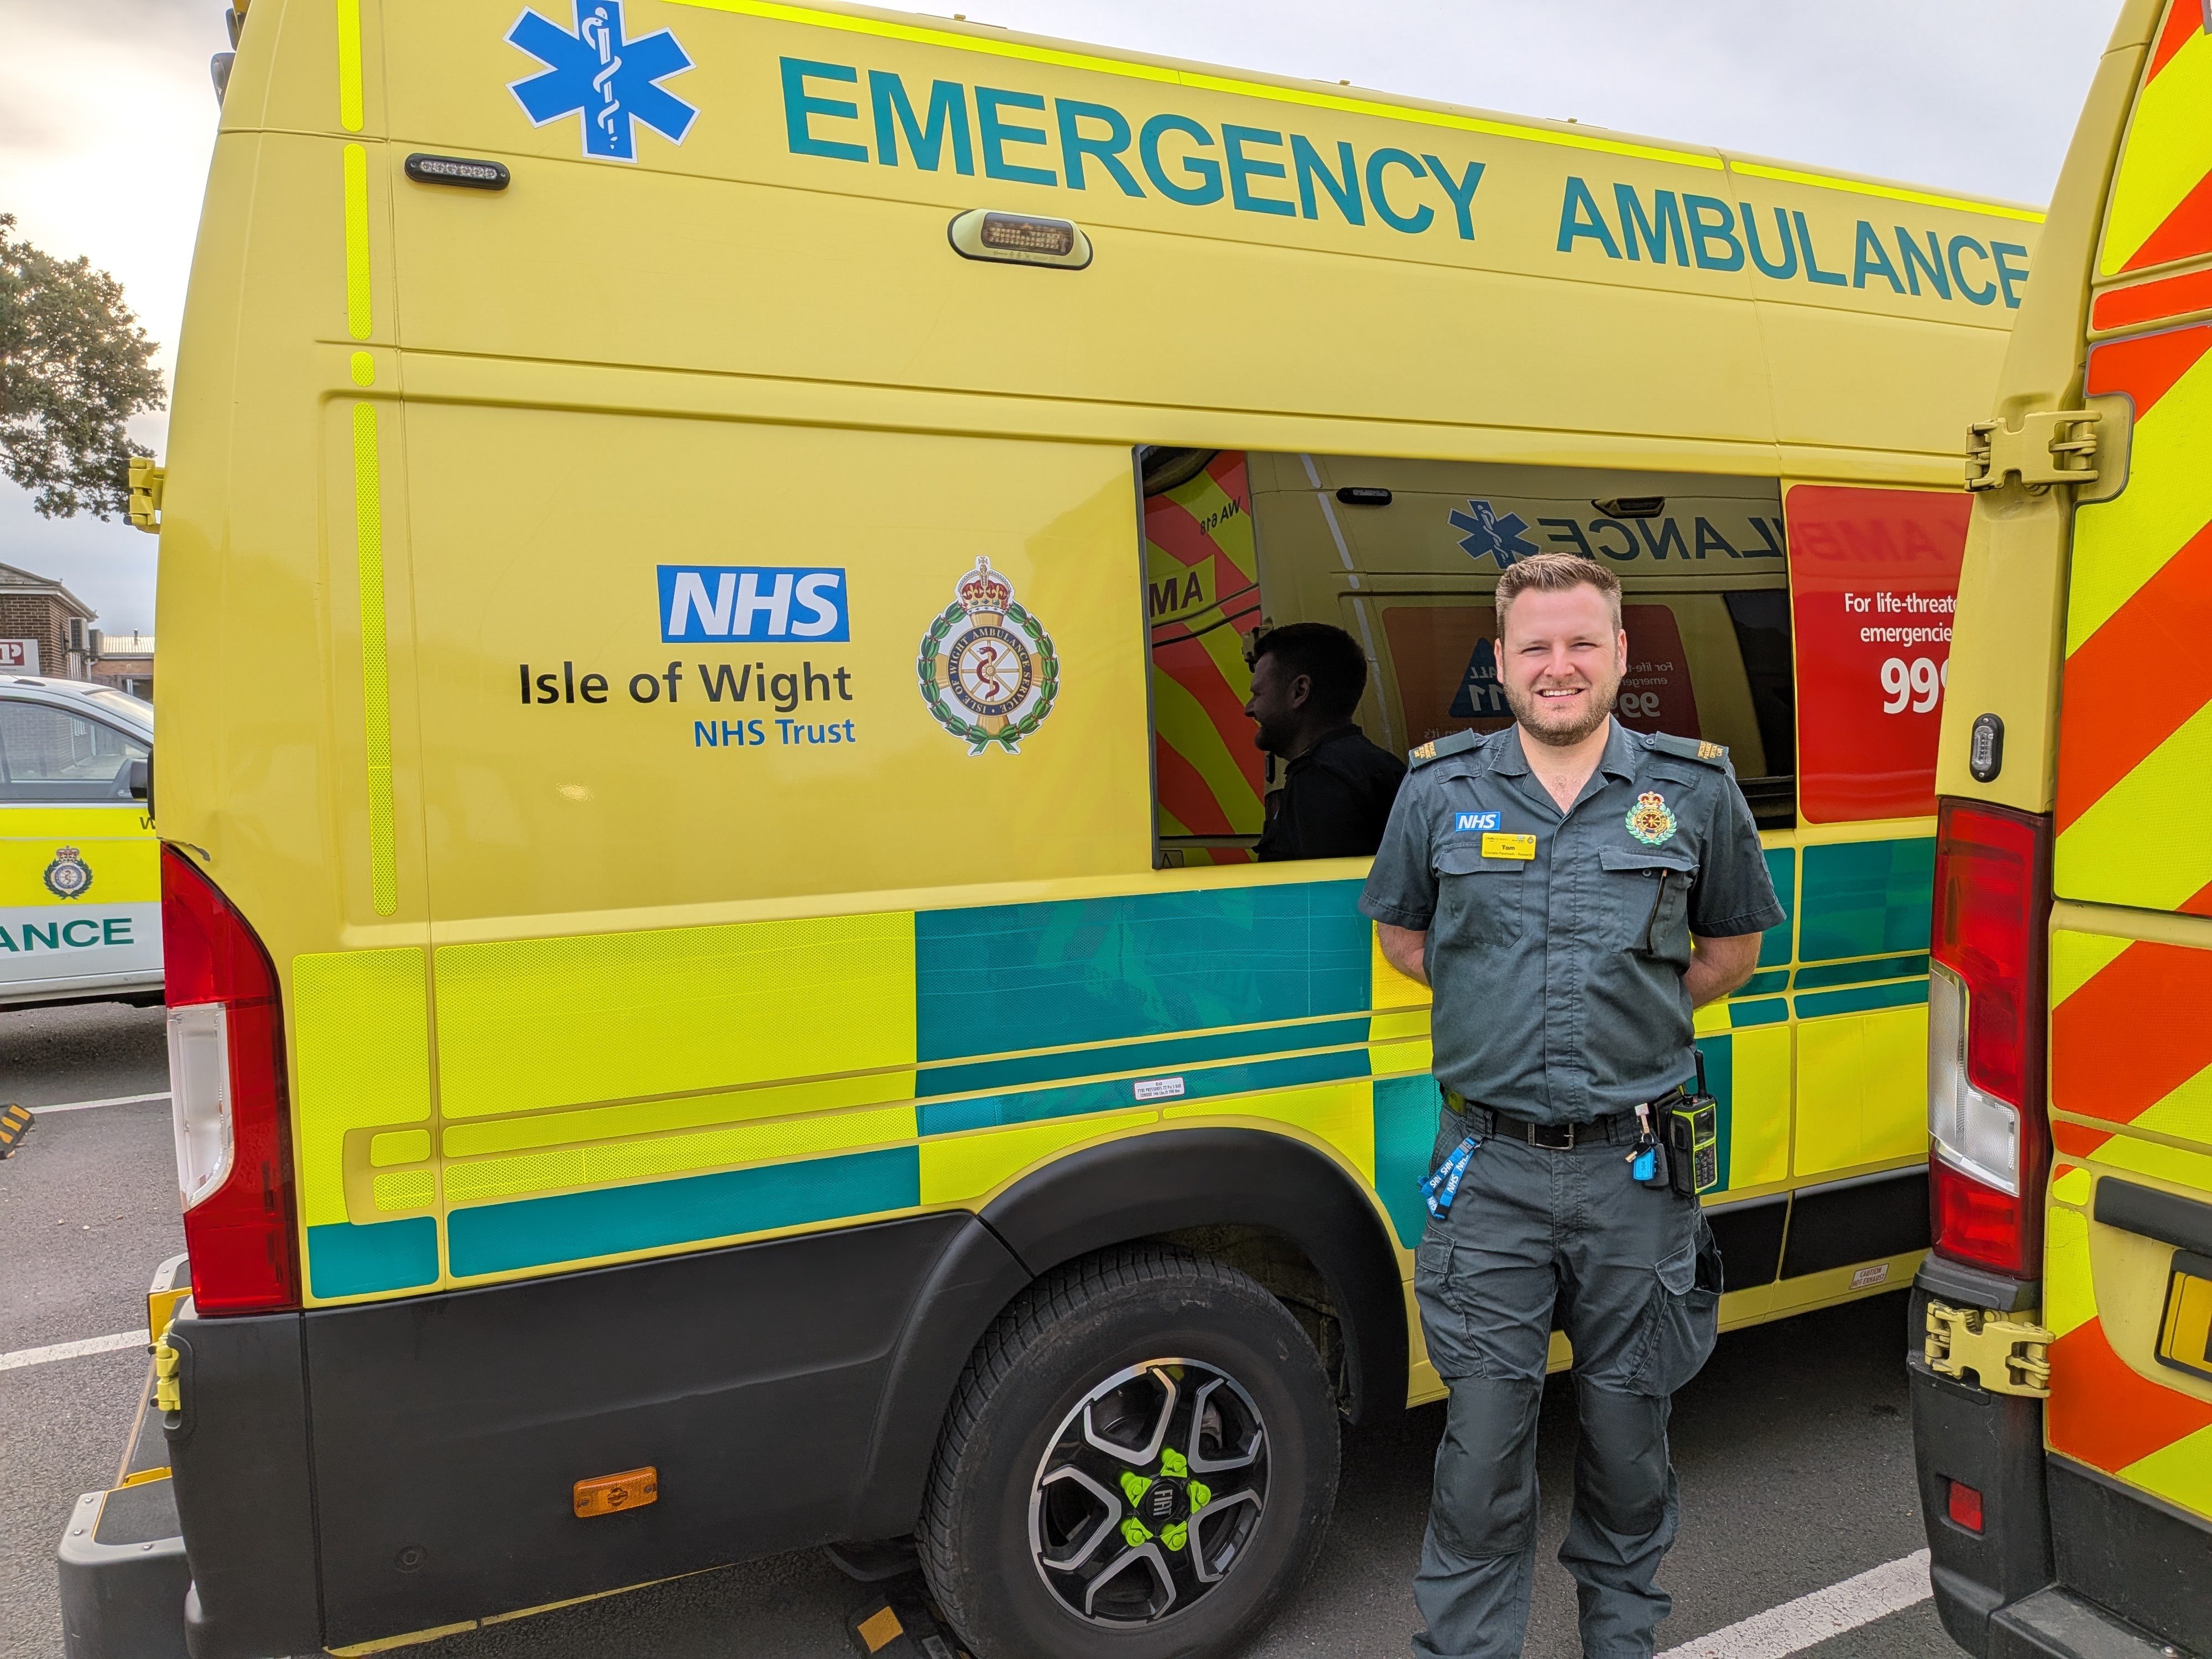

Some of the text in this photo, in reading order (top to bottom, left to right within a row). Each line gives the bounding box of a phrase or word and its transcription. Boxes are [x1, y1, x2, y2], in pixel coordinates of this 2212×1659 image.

[779, 56, 2030, 309] EMERGENCY AMBULANCE
[668, 572, 840, 636] NHS
[1845, 593, 1871, 612] For
[1860, 622, 1952, 647] emergencie
[950, 628, 1030, 713] ISLE OF WIGHT AMBULANCE SERVICE
[520, 661, 853, 712] Isle of Wight
[694, 718, 855, 747] NHS Trust
[1458, 814, 1496, 829] NHS
[1441, 1160, 1454, 1175] NHS
[1430, 1175, 1442, 1188] NHS
[1446, 1173, 1459, 1193] NHS
[1860, 1267, 1882, 1277] CAUTION
[1863, 1274, 1885, 1284] EXHAUST
[1154, 1489, 1173, 1516] FIAT
